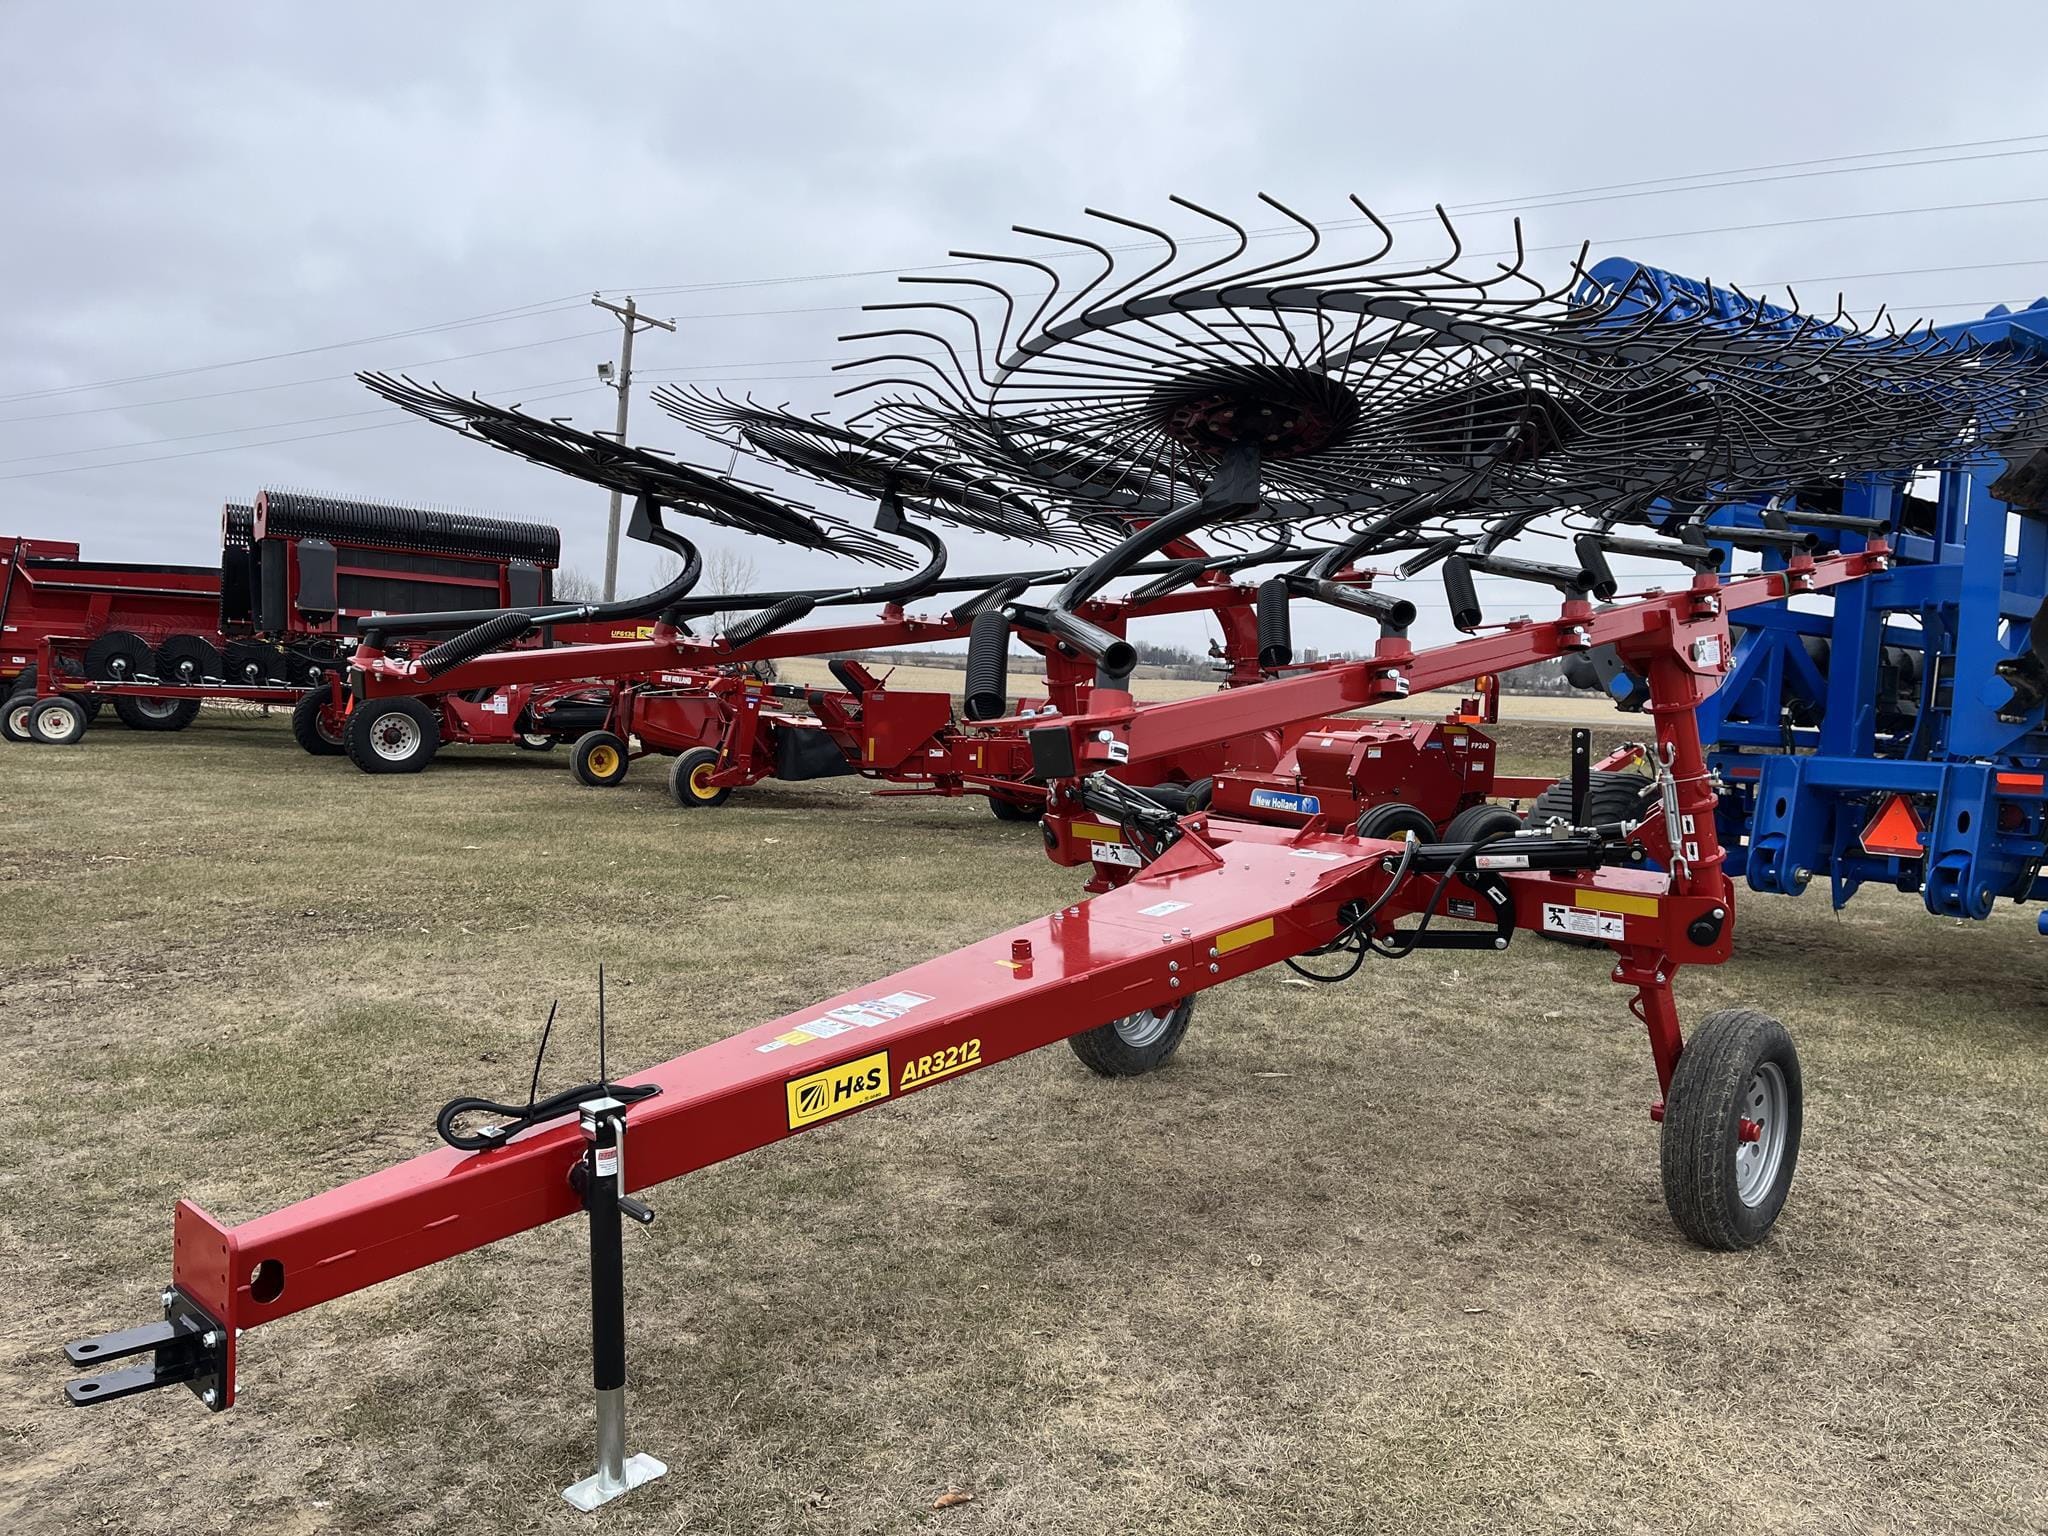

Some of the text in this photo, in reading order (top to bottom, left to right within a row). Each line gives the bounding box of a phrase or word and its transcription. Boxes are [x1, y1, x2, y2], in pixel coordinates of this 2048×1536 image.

[1256, 795, 1298, 811] New Holland
[900, 1038, 982, 1086] AR3212
[833, 1067, 882, 1103] H&S
